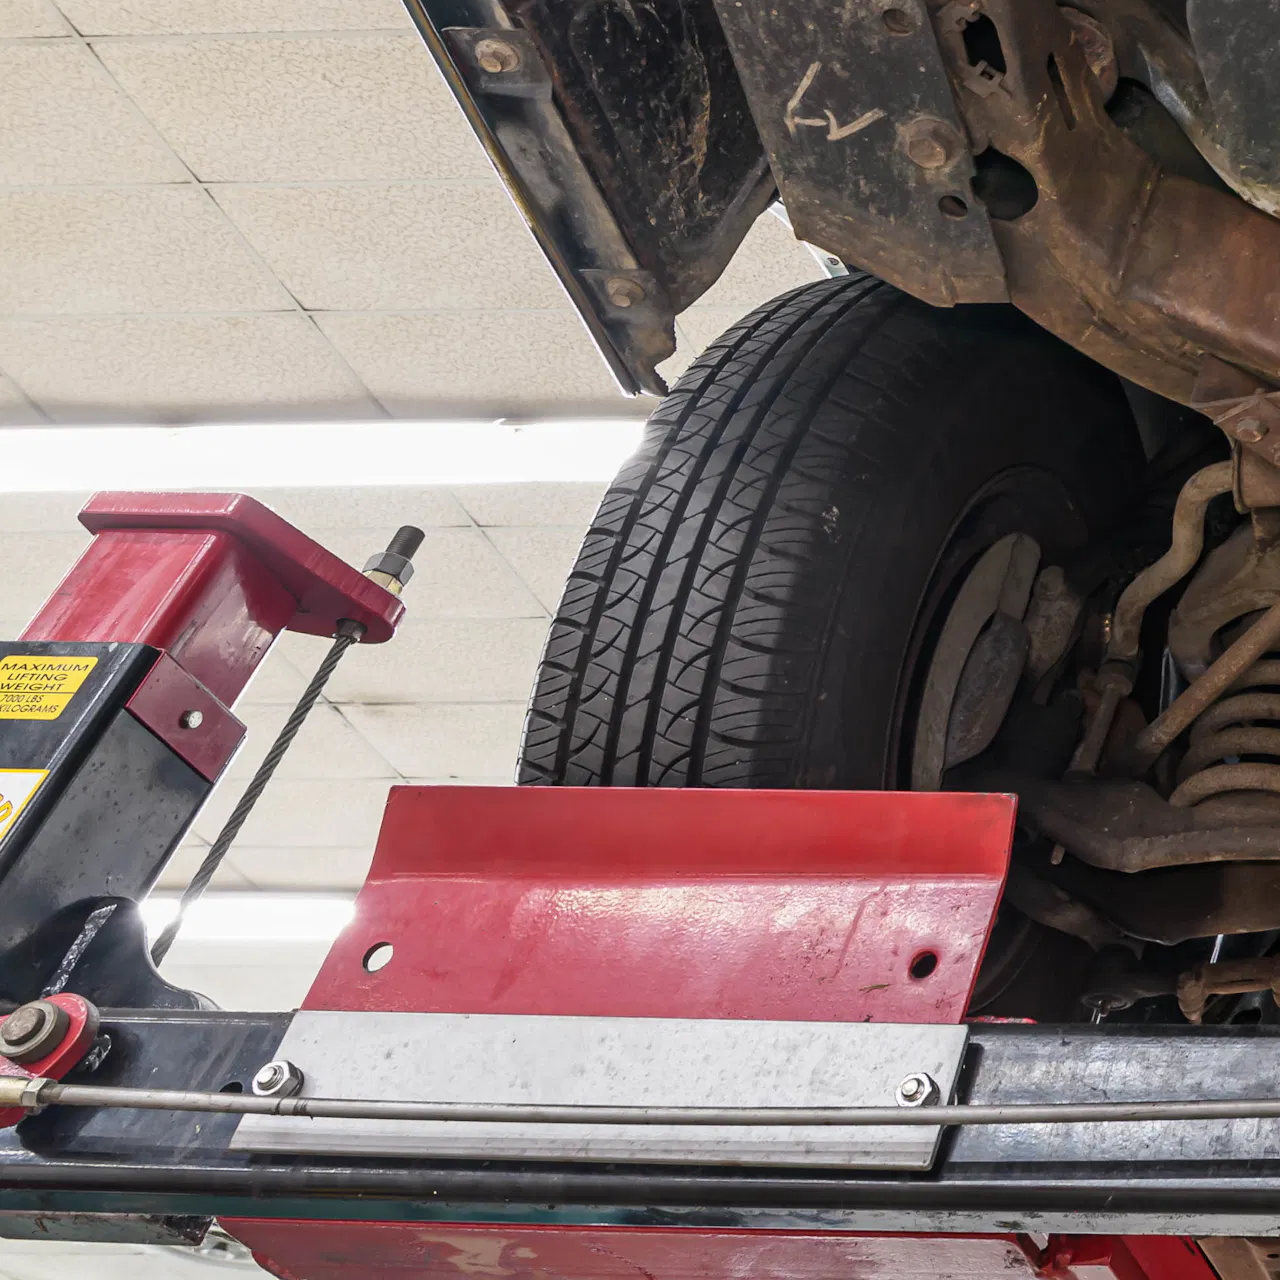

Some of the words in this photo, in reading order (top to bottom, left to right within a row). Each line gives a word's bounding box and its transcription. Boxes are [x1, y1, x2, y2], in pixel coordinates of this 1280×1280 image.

[1, 663, 89, 671] MAXIMUM
[7, 673, 68, 681] LIFTING
[0, 683, 64, 691] WEIGHT
[26, 694, 44, 703] LBS
